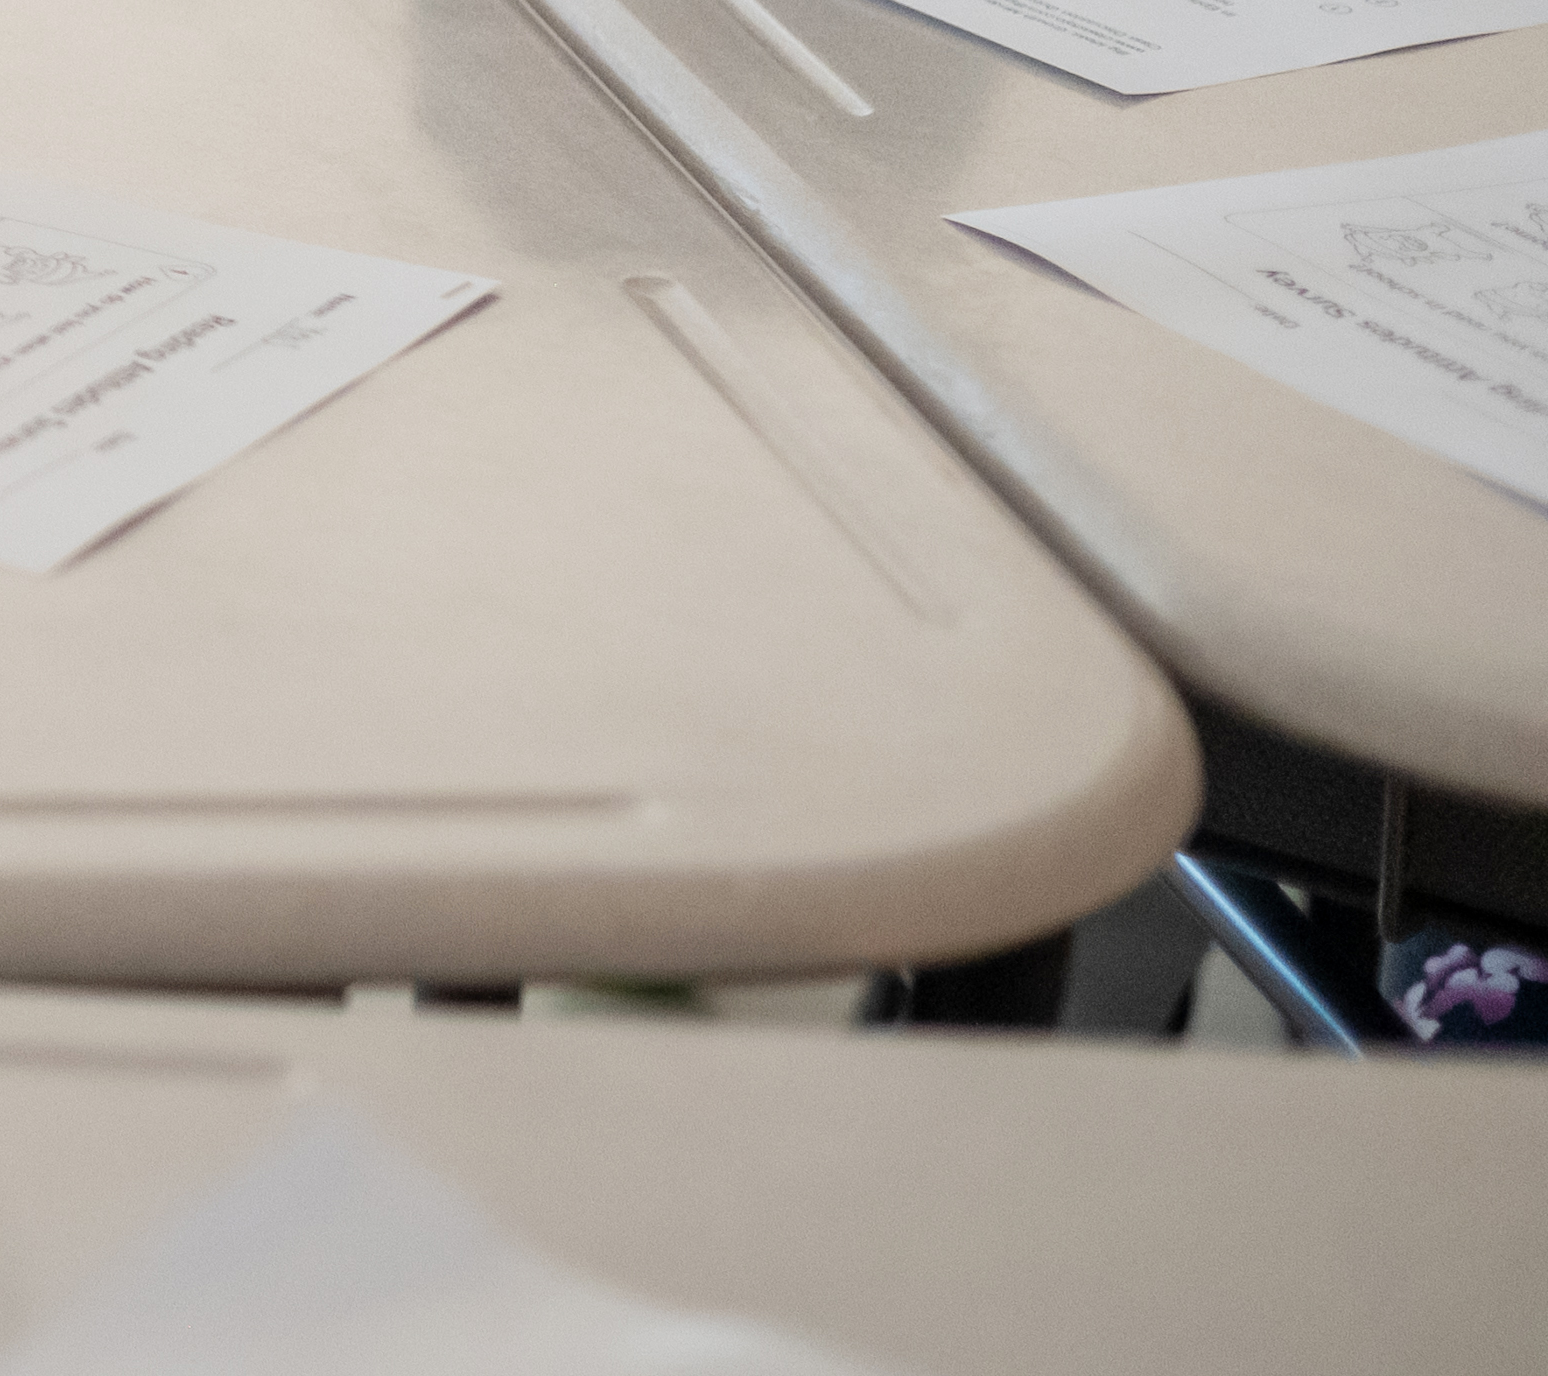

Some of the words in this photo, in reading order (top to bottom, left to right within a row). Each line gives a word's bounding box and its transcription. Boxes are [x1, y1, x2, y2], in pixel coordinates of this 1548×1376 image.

[120, 276, 155, 295] How
[1256, 267, 1356, 320] Survey
[74, 303, 103, 321] you
[136, 314, 236, 361] Reading
[1357, 319, 1490, 382] Attitudes
